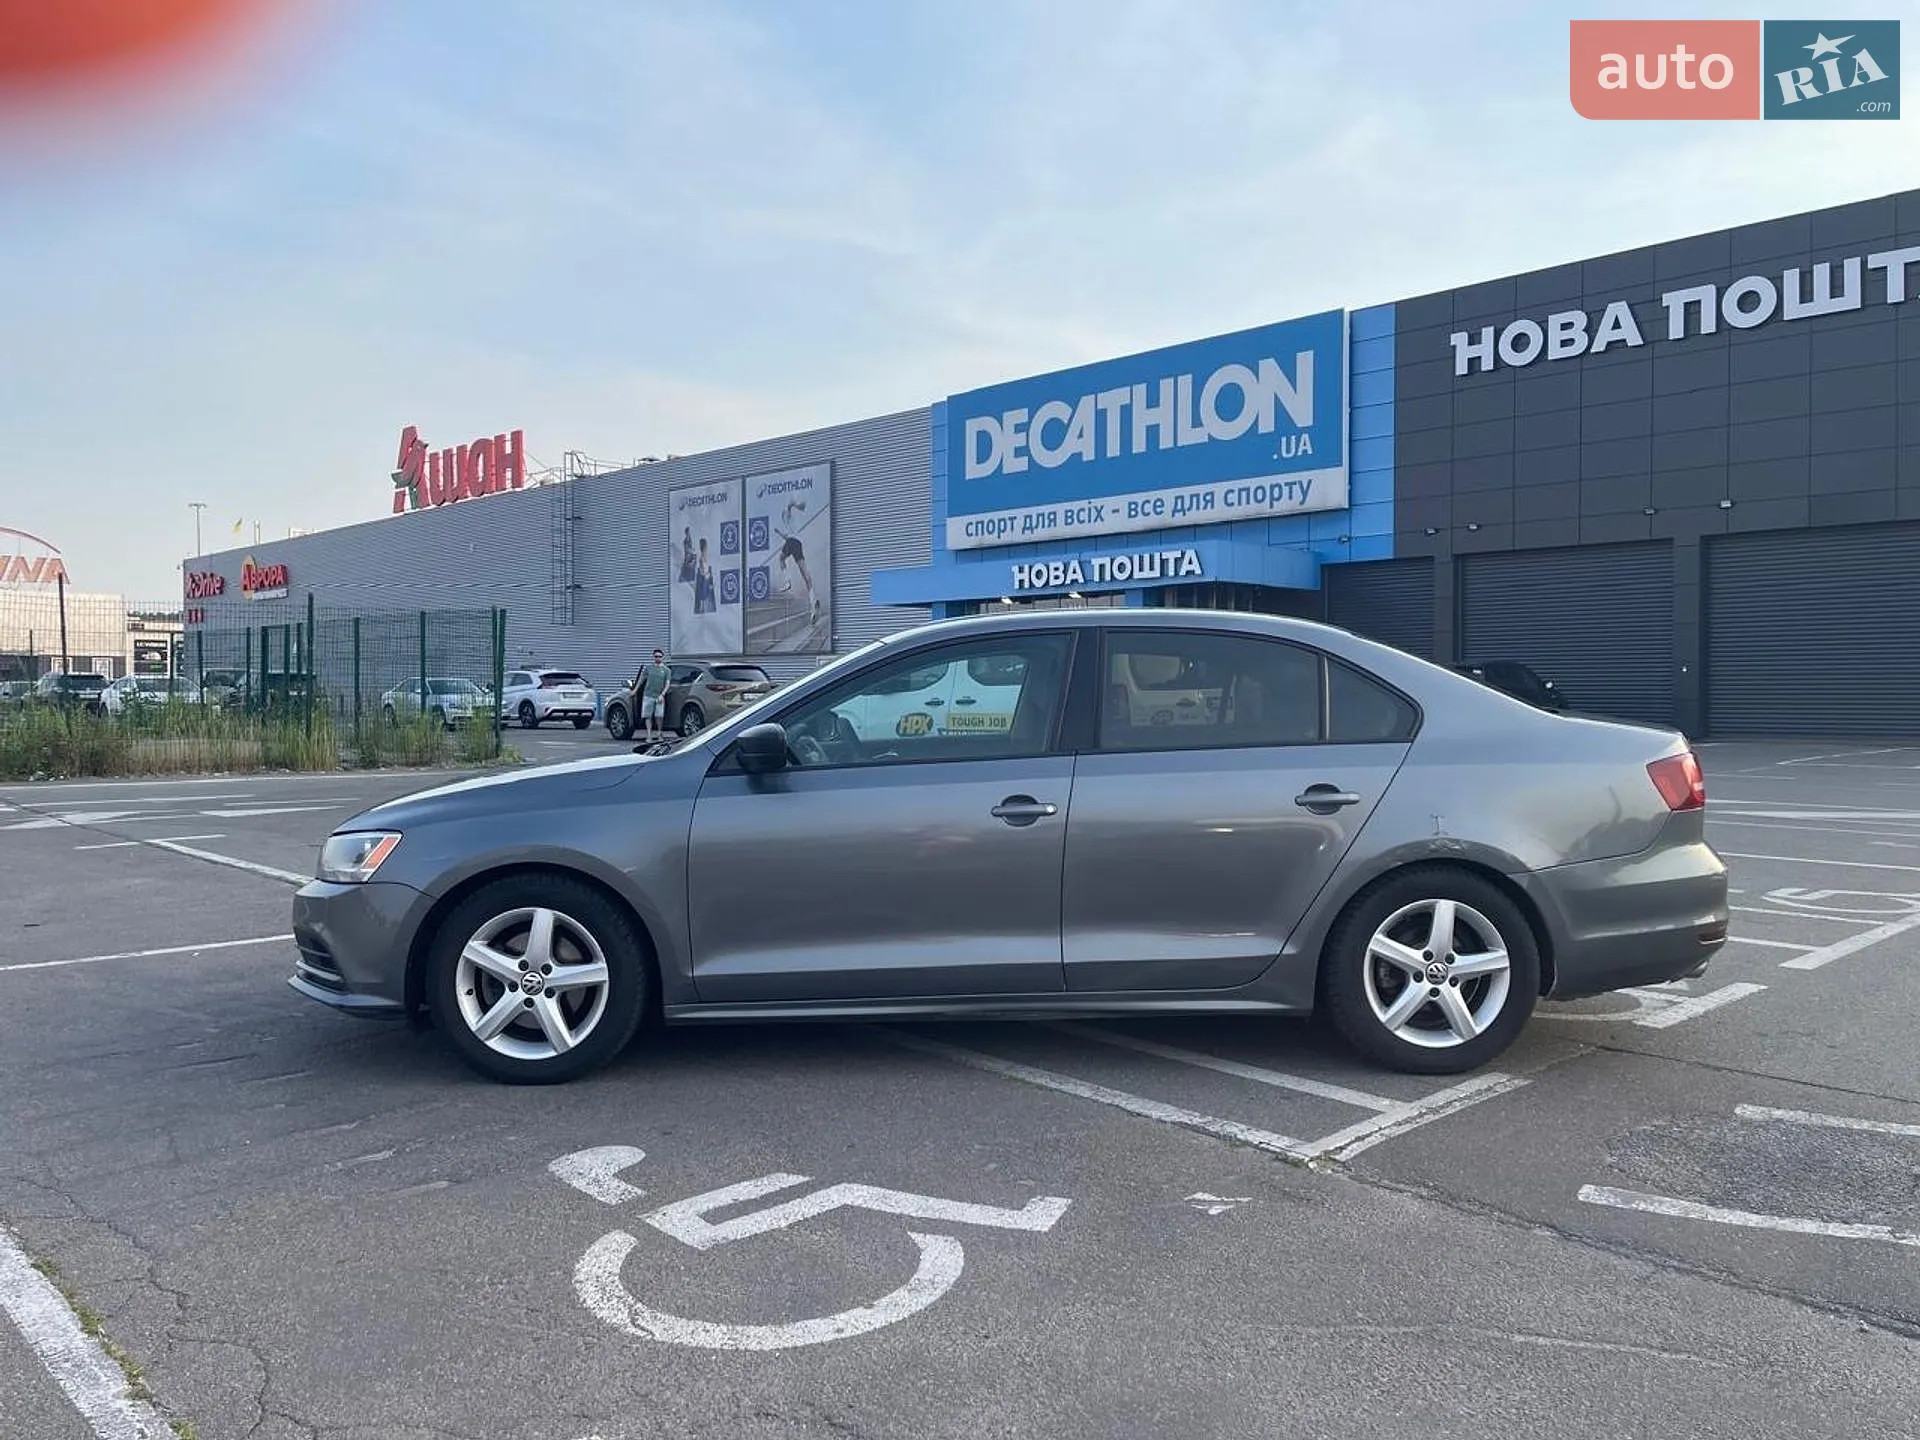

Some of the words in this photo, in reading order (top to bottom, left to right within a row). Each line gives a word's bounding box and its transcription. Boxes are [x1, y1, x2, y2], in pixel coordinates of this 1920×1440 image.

[1449, 300, 1645, 377] НОВА
[1661, 246, 1920, 341] ПОШТ
[965, 349, 1315, 481] DECATHLON
[1272, 432, 1314, 461] .UA
[767, 477, 813, 496] DECATHLON
[965, 515, 1018, 539] спорт
[1021, 510, 1058, 535] для
[1063, 501, 1105, 526] всіх
[1127, 497, 1166, 519] все
[1171, 491, 1216, 518] для
[1223, 478, 1313, 509] спорту
[1011, 559, 1086, 590] НОВА
[1090, 549, 1203, 583] ПОШТА
[951, 716, 985, 728] TOUGH
